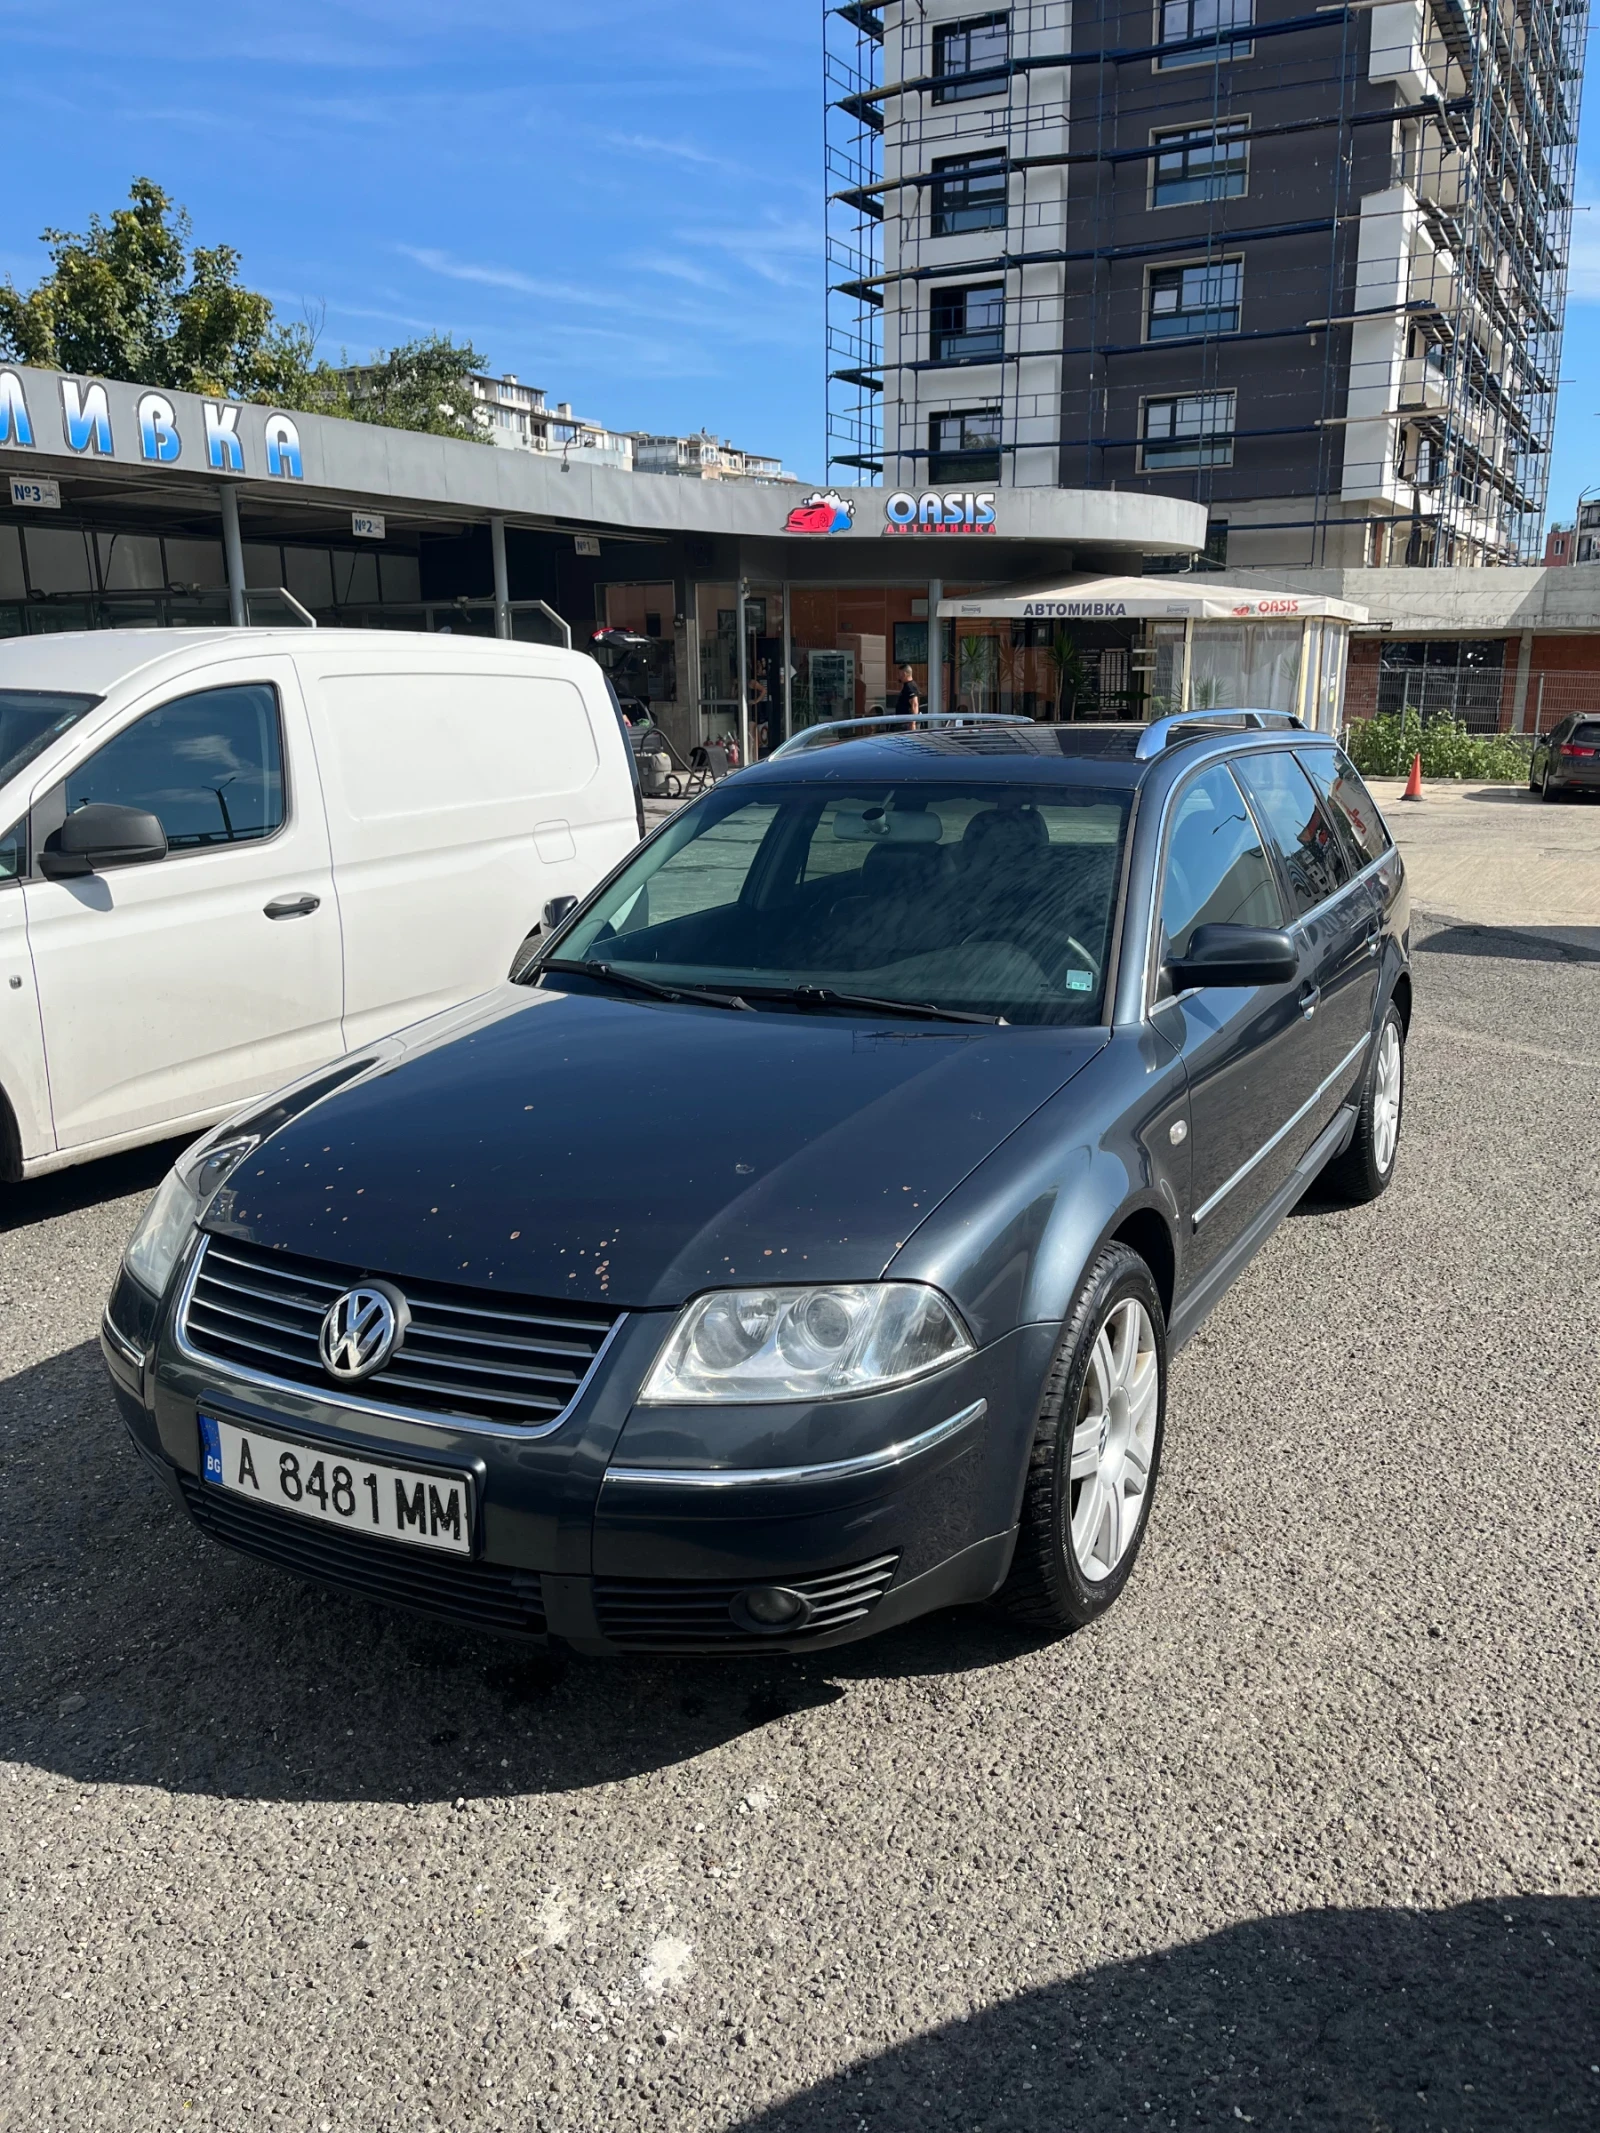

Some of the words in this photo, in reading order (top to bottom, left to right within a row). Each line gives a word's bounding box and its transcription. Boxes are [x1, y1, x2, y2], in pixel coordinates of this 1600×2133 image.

[886, 491, 997, 524] OASIS
[885, 524, 996, 534] АВТОМИВКА
[1023, 603, 1127, 616] АВТОМИВКА
[1258, 600, 1299, 612] OASIS
[207, 1454, 222, 1474] BG
[238, 1437, 260, 1490] A
[279, 1451, 380, 1525] 8481
[395, 1478, 461, 1541] MM
